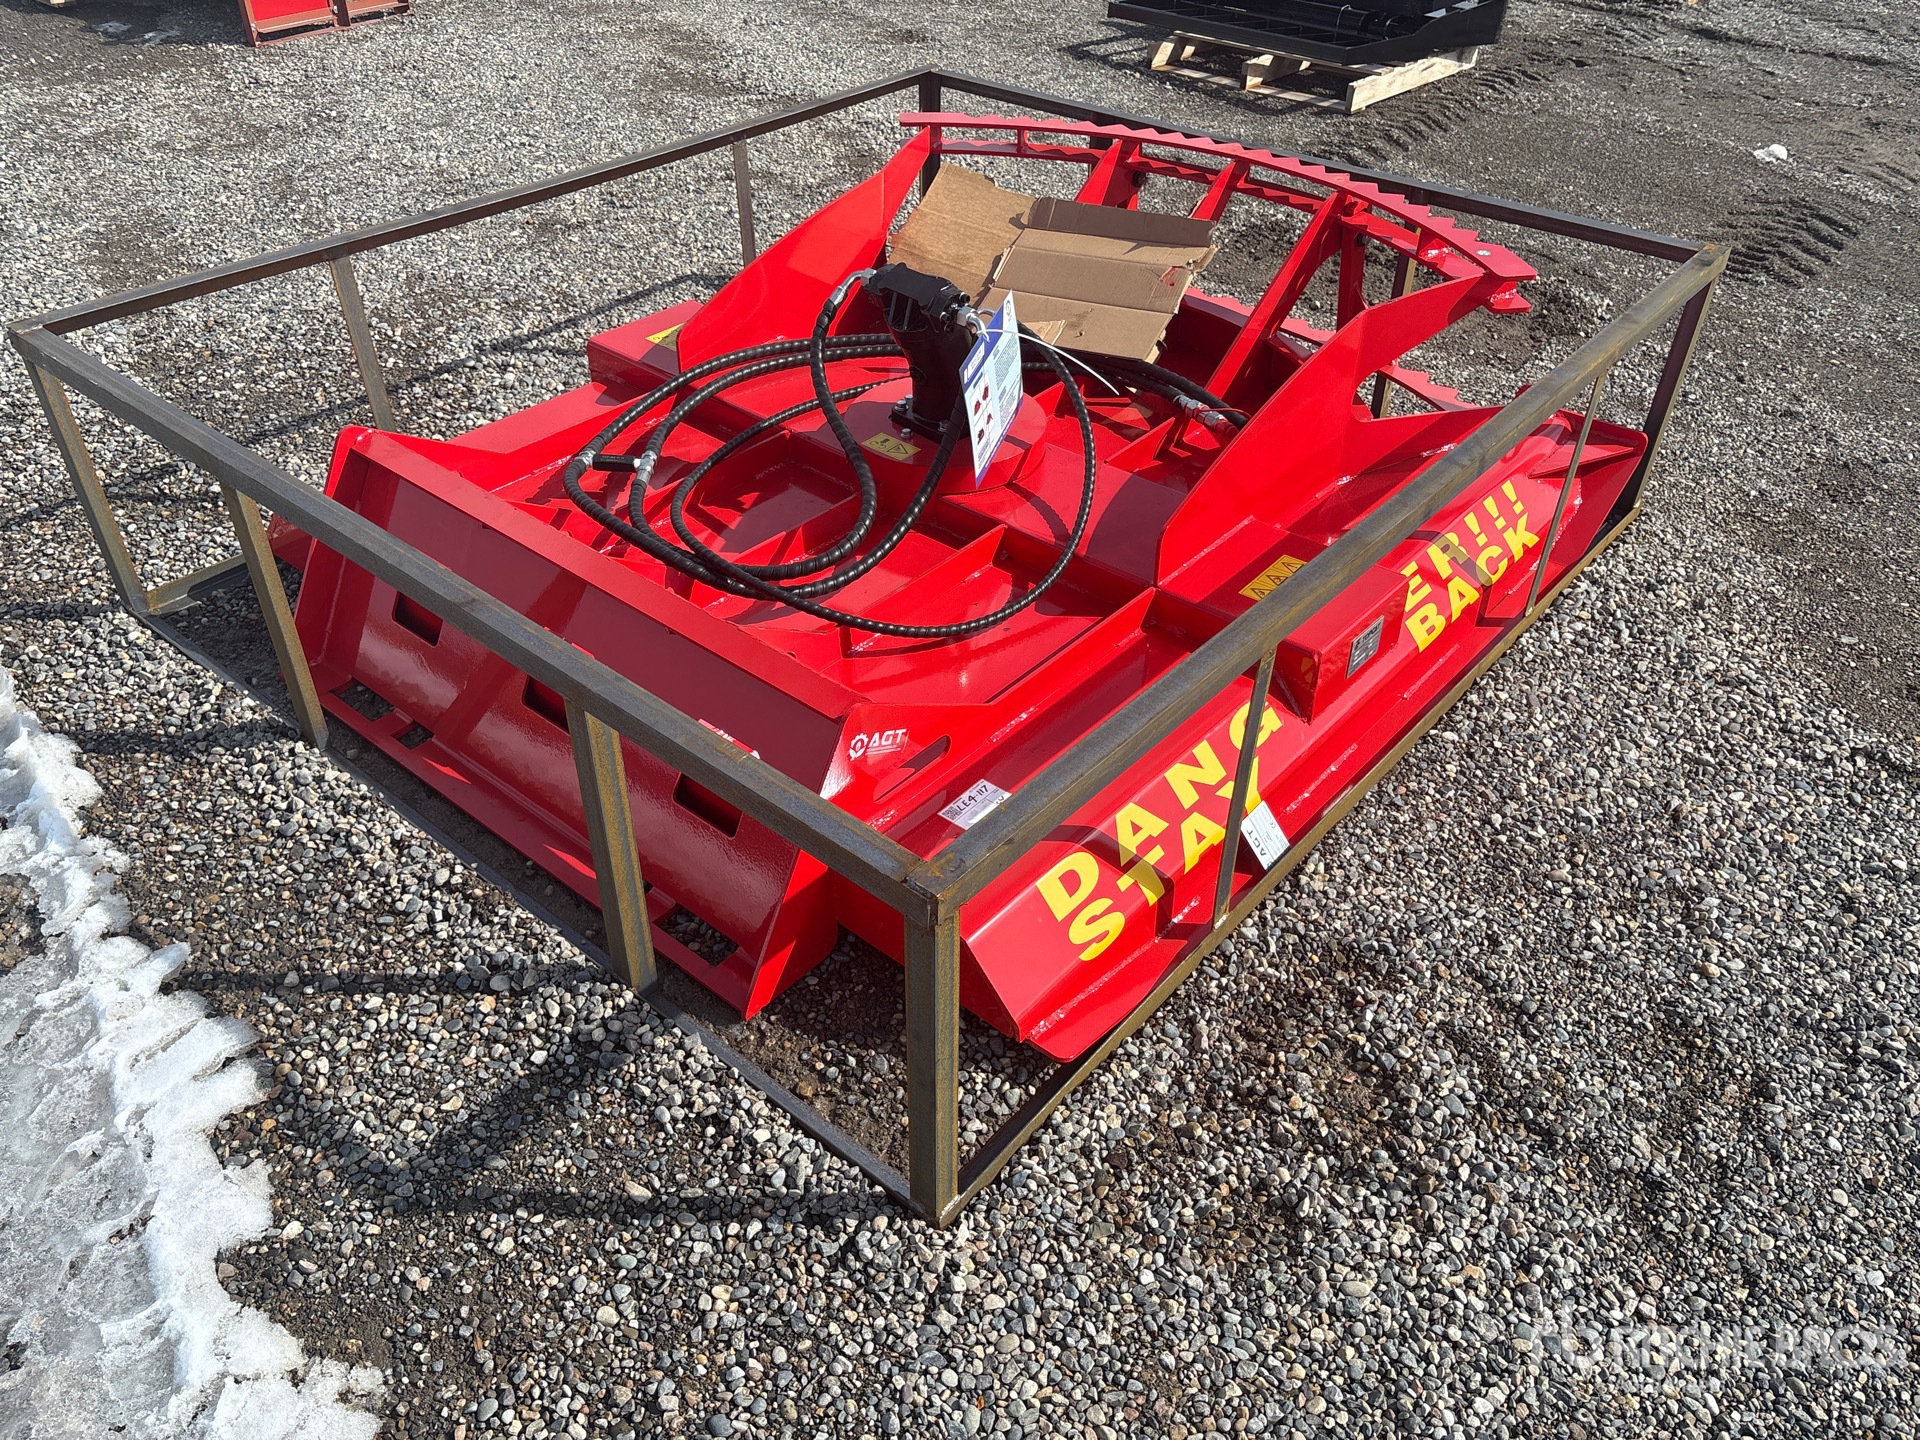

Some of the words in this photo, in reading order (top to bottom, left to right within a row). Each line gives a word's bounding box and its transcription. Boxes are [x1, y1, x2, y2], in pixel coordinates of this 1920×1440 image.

[868, 728, 907, 748] AGT
[1069, 755, 1263, 963] STAY
[1405, 513, 1540, 653] BACK
[956, 784, 989, 812] LE4-117
[1246, 828, 1268, 857] AGT
